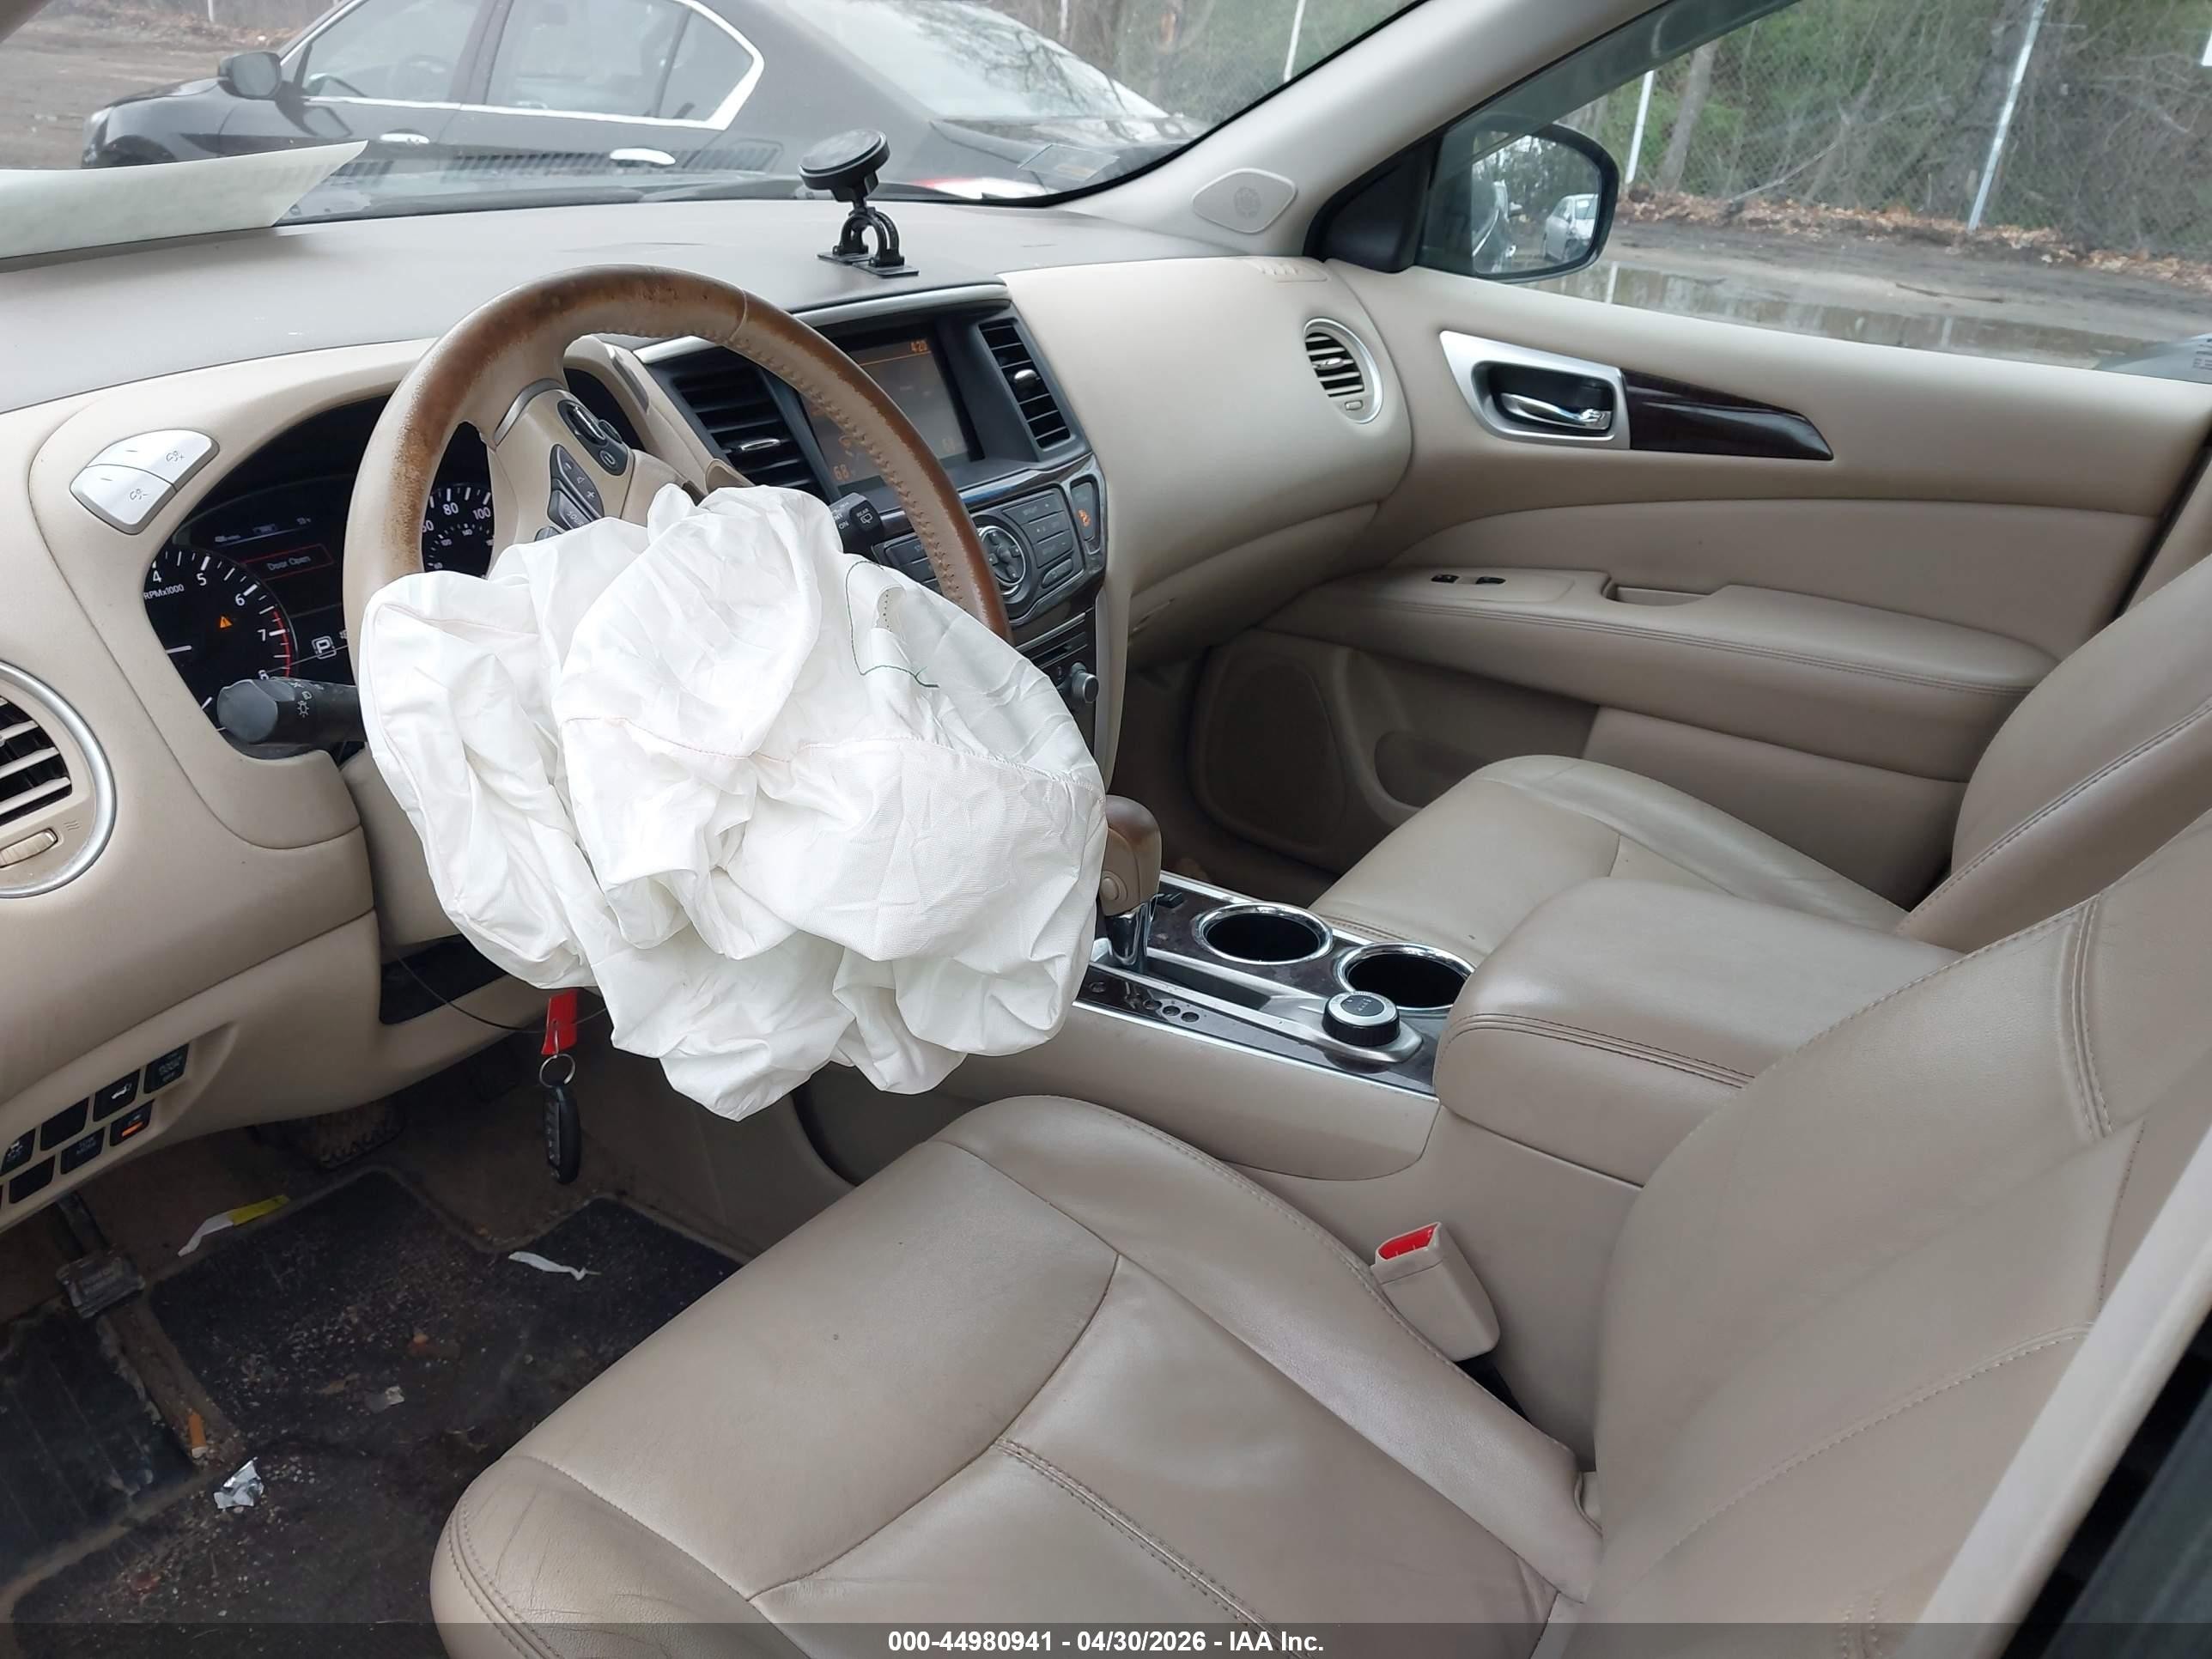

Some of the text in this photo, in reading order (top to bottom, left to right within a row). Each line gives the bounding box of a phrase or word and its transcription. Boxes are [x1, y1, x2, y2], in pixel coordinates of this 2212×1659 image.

[442, 501, 459, 516] 80
[472, 507, 491, 520] 100
[838, 520, 849, 530] ON
[152, 570, 162, 583] 4
[196, 573, 207, 586] 5
[234, 592, 246, 606] 6
[257, 629, 266, 642] 7
